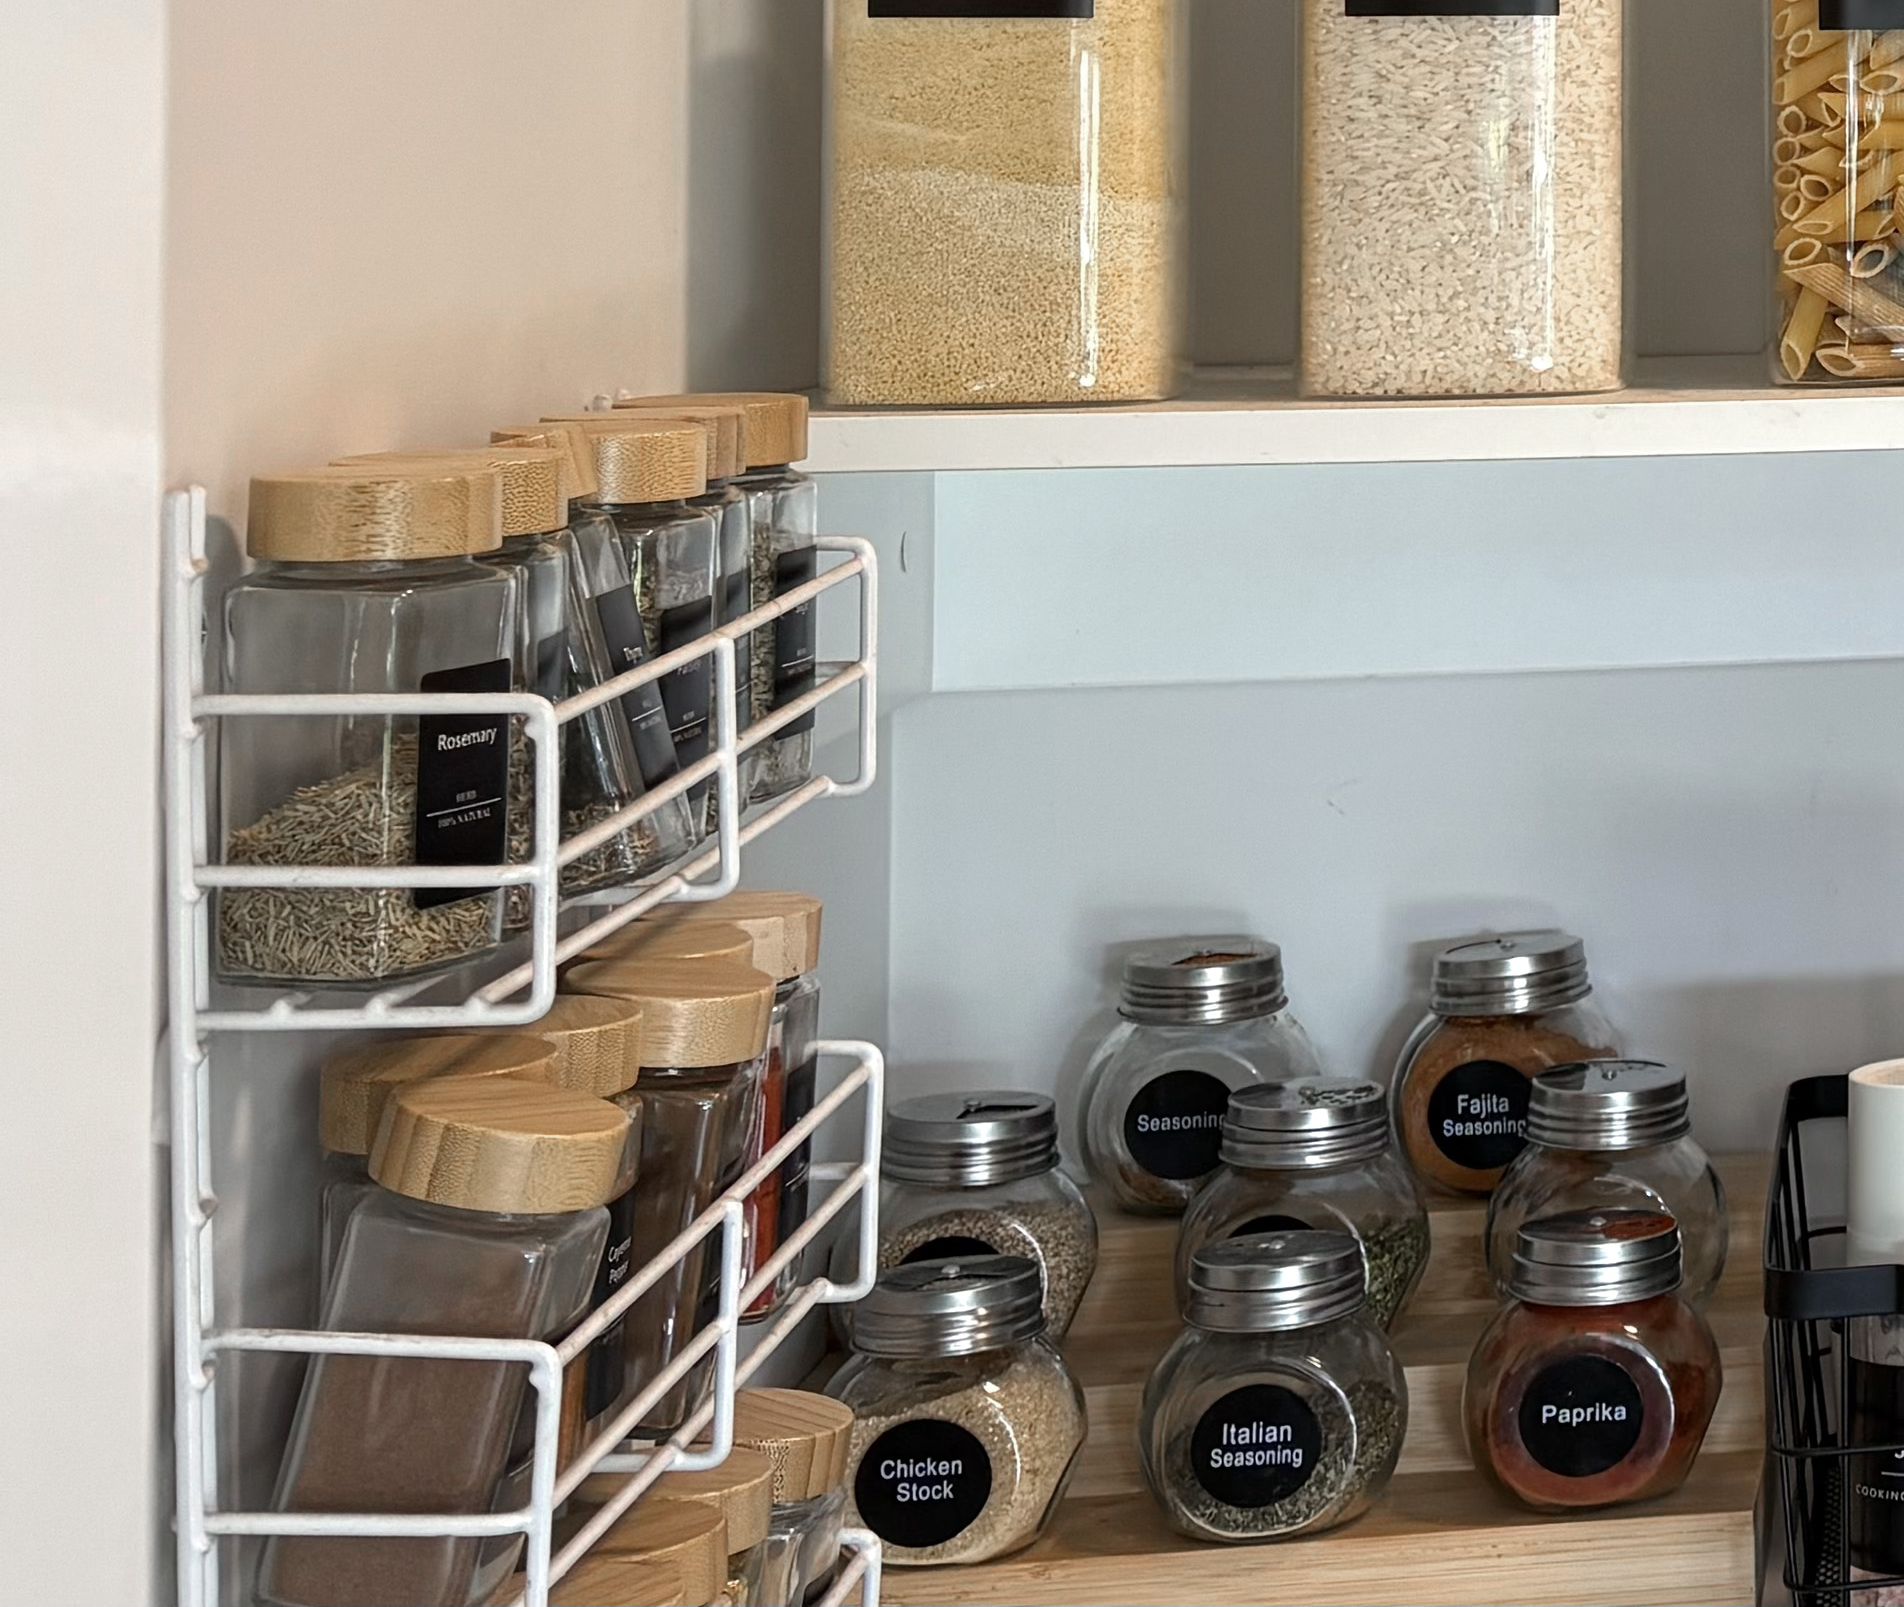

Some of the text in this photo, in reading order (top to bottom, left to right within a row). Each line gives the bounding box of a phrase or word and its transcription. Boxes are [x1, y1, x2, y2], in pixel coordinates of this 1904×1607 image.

[437, 727, 498, 752] Rosemary
[1456, 1093, 1510, 1118] Fajita
[1442, 1115, 1526, 1138] Seasoning
[1541, 1402, 1628, 1428] Paprika
[1221, 1422, 1293, 1444] Italian
[1210, 1443, 1304, 1469] Seasoning
[880, 1457, 964, 1481] Chicken
[896, 1480, 955, 1503] Stock
